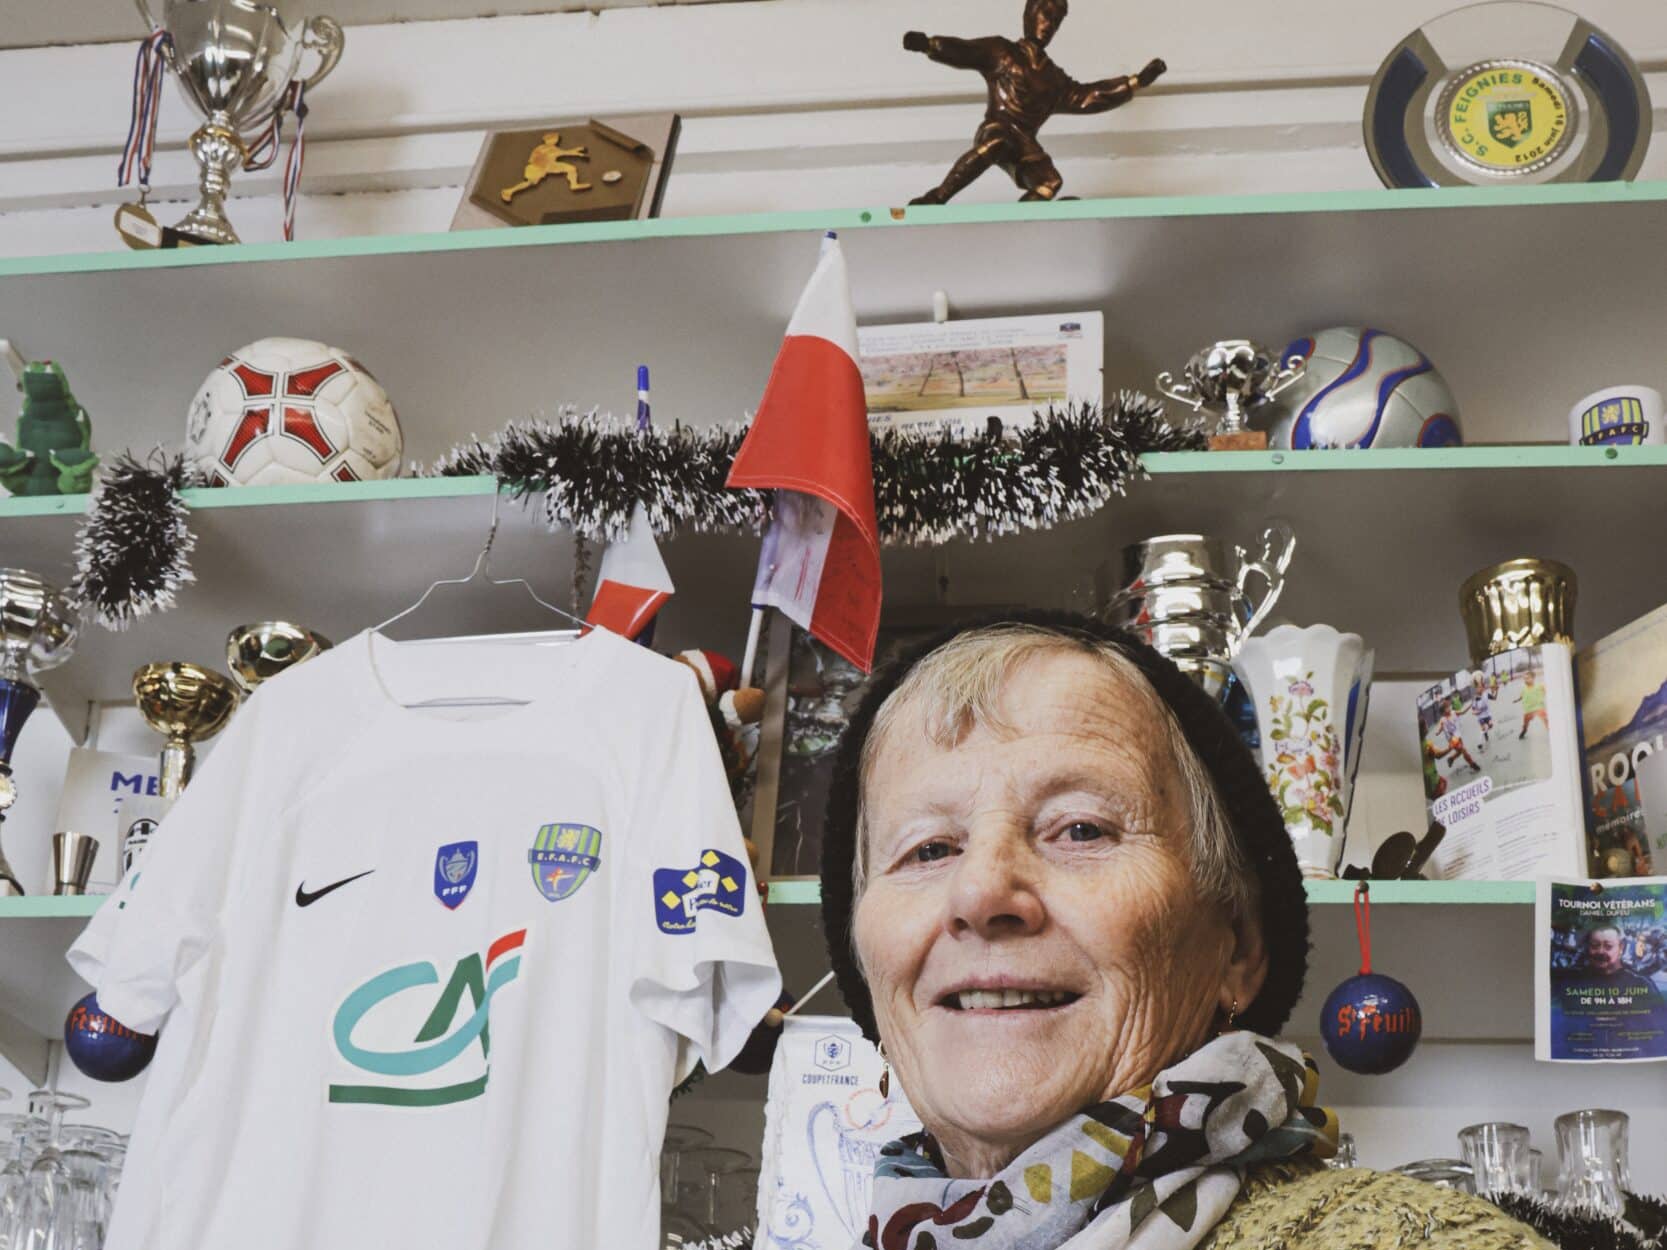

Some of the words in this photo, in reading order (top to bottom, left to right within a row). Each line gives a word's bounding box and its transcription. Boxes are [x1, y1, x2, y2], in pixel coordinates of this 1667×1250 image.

[1454, 73, 1523, 123] FEIGNIES
[1532, 77, 1562, 110] Samedi
[1515, 146, 1543, 163] 2012
[1434, 800, 1449, 816] LES
[1450, 779, 1490, 808] ACCUEILS
[1448, 801, 1481, 824] LOISIRS
[442, 884, 468, 897] FFF
[1559, 899, 1601, 910] TOURNOI
[1565, 986, 1605, 997] SAMEDI
[1608, 986, 1620, 996] 10
[1624, 986, 1649, 996] JUIN
[1580, 997, 1592, 1005] DE
